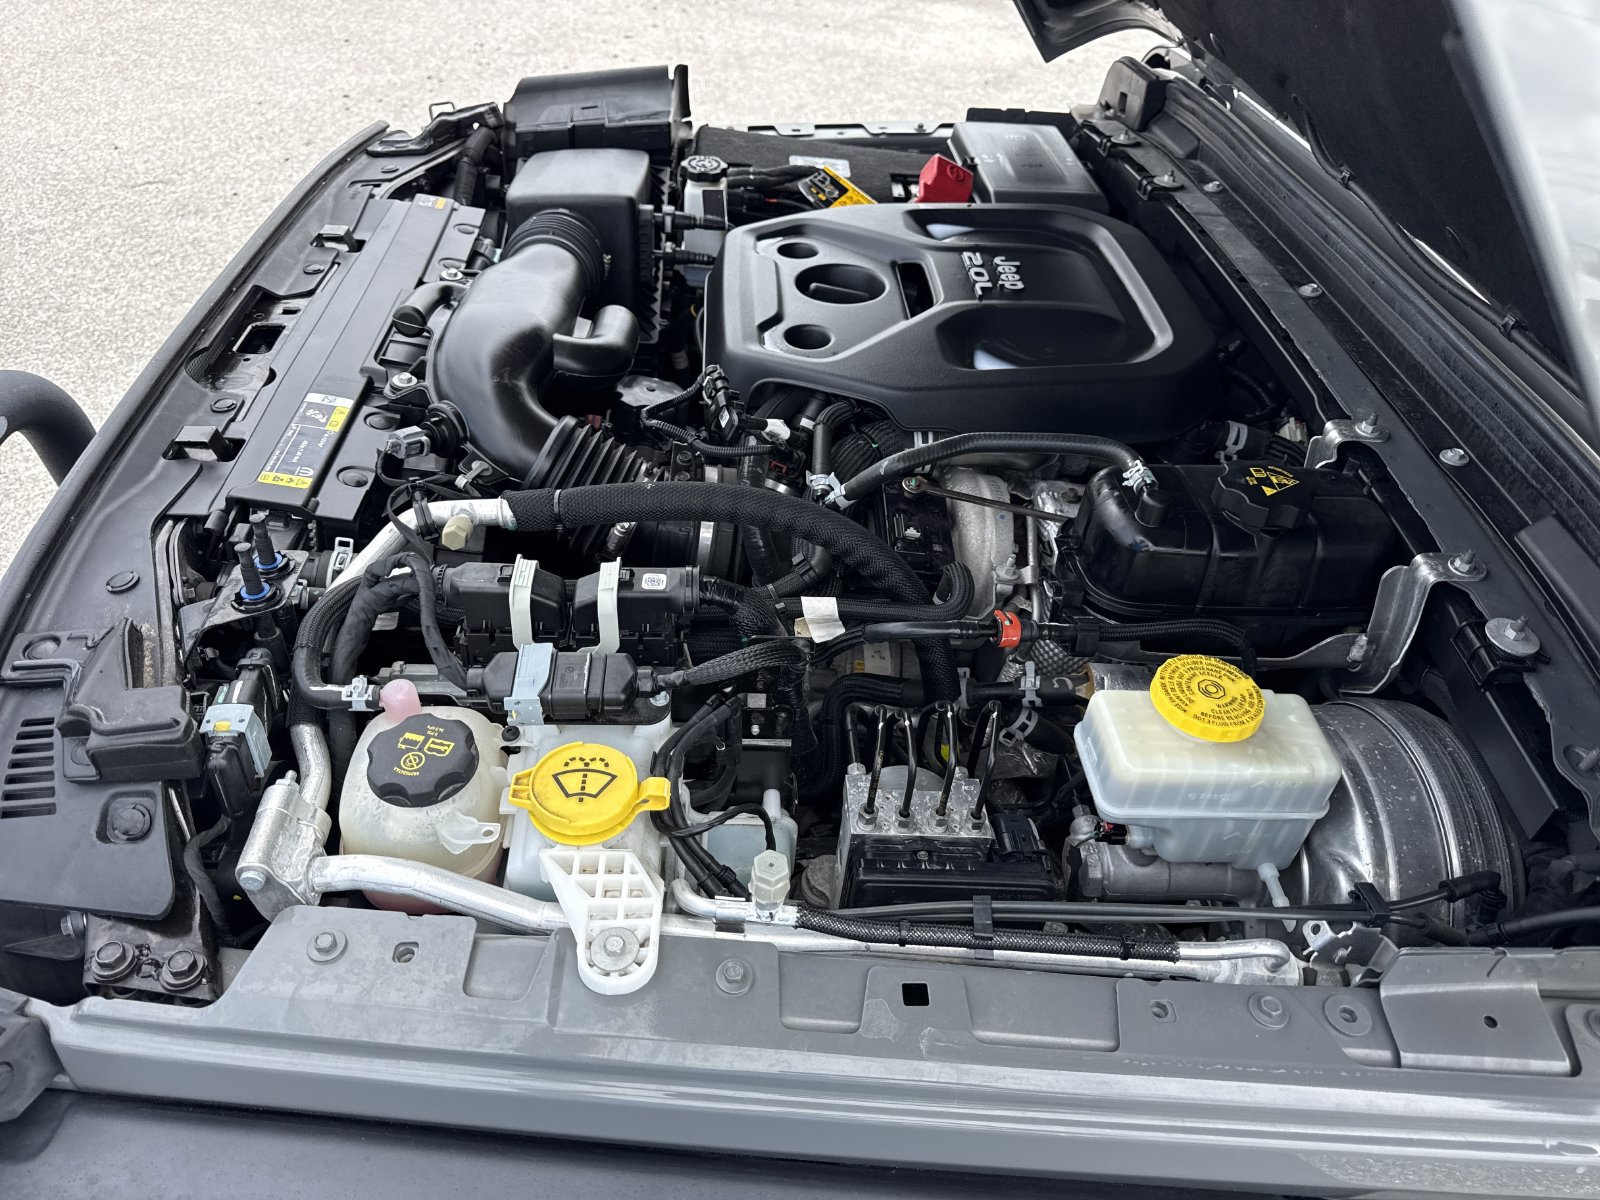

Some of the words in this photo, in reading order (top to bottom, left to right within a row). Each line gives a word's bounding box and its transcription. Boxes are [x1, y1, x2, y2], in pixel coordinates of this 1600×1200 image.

[962, 251, 992, 297] 2.0L
[994, 256, 1024, 290] Jeep
[1205, 662, 1242, 679] UNIQUEMENT
[1216, 696, 1238, 708] WARNING
[1193, 714, 1205, 722] DOT
[1201, 712, 1225, 721] BEFORE
[1226, 708, 1250, 720] REMOVING
